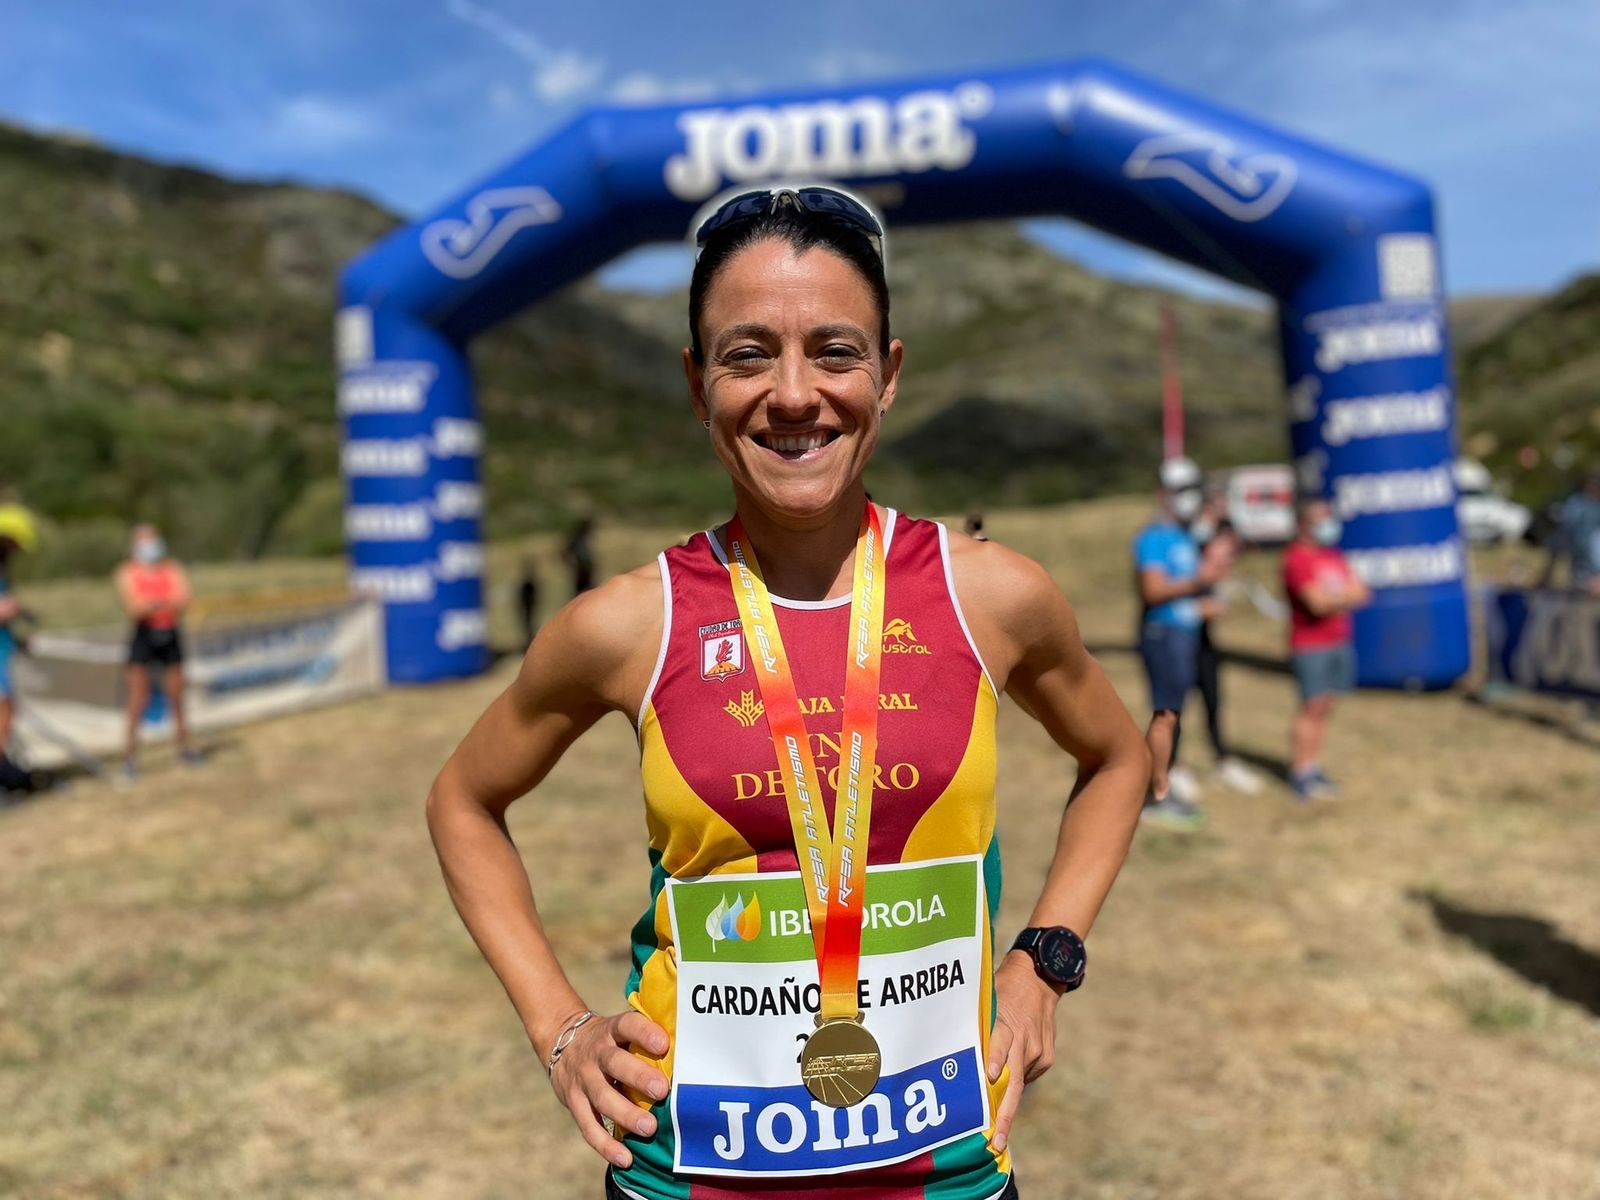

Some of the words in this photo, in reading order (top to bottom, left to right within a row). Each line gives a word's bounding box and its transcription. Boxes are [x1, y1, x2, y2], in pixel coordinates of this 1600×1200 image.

[732, 540, 762, 619] ATLETISMO
[862, 527, 875, 614] ATLETISMO
[882, 644, 932, 655] ustral
[797, 697, 836, 716] AJA
[784, 735, 818, 841] ATLETISMO
[844, 731, 863, 842] ATLETISMO
[691, 976, 822, 1016] CARDAÑO
[880, 959, 966, 1007] ARRIBA
